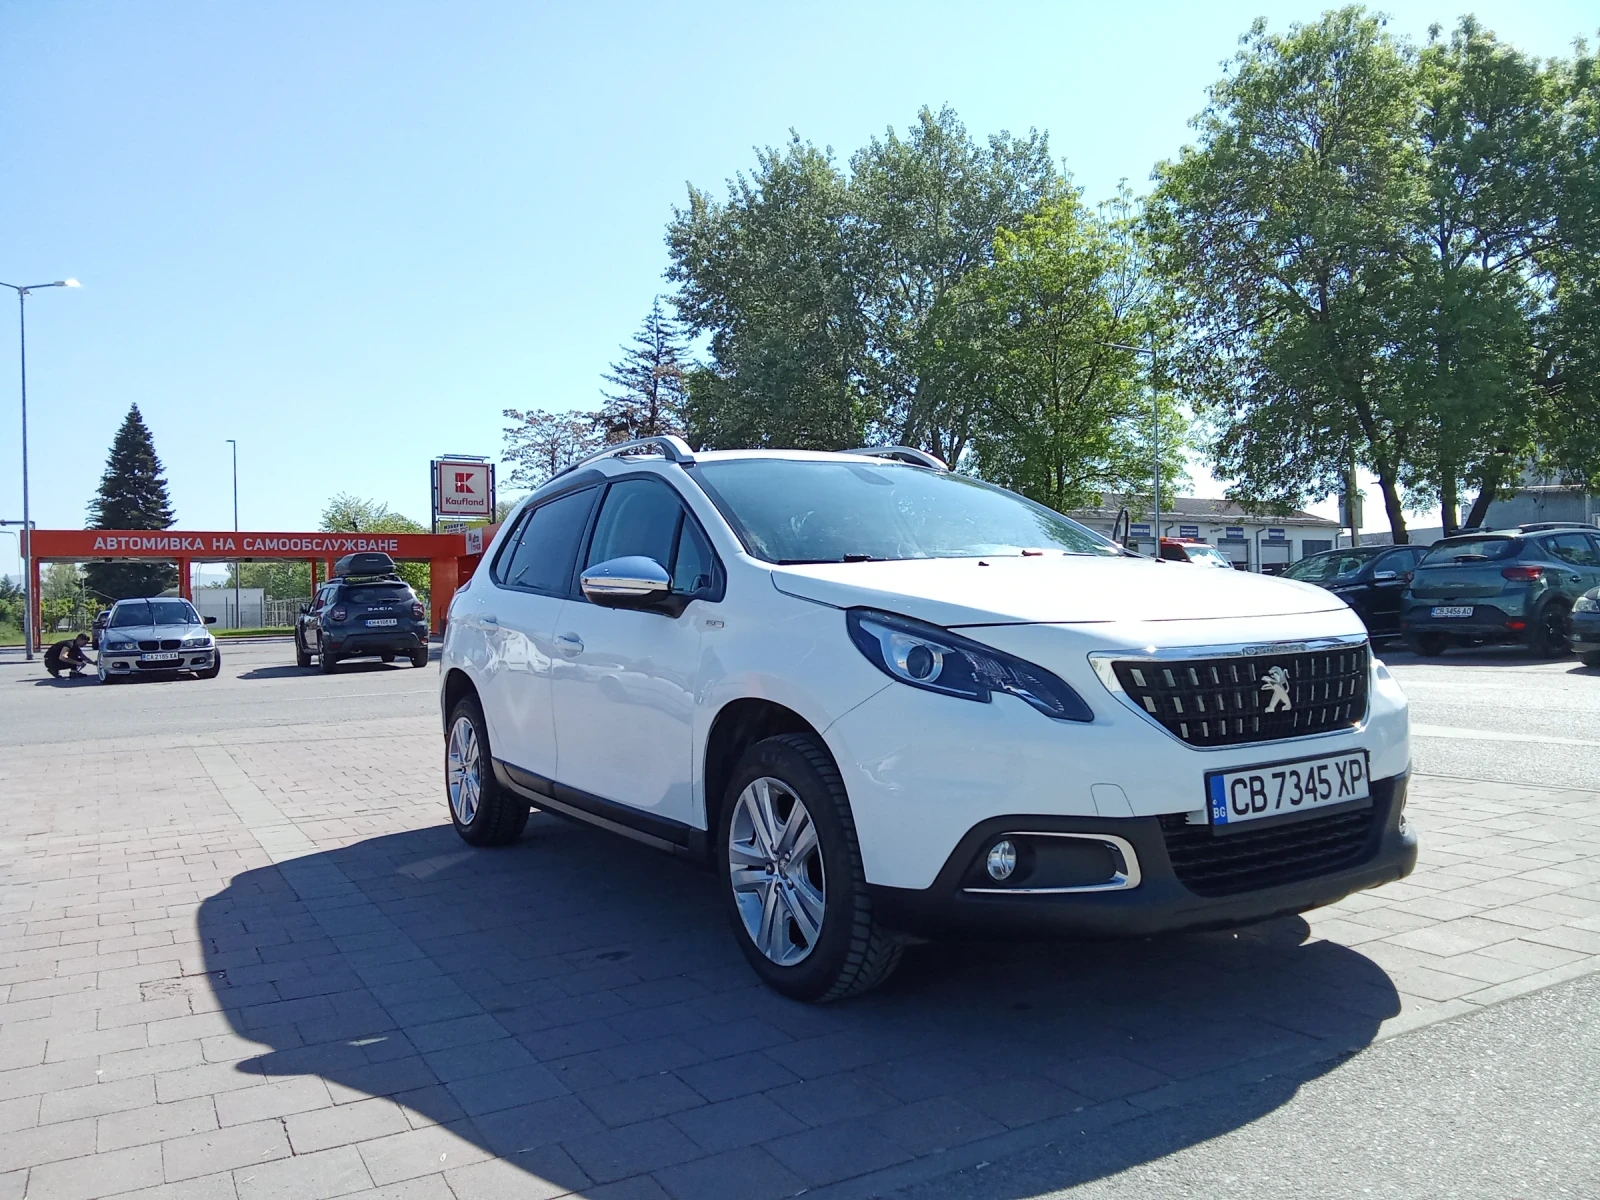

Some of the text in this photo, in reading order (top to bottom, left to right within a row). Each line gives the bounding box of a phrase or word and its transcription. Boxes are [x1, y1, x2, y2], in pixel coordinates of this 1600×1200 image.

[445, 497, 484, 506] Kaufland
[93, 537, 398, 551] АВТОМИВКА НА САМООБСЛУЖВАНЕ
[1445, 607, 1461, 615] 3456
[1230, 759, 1363, 816] CB 7345 XP
[1213, 806, 1226, 819] BG
